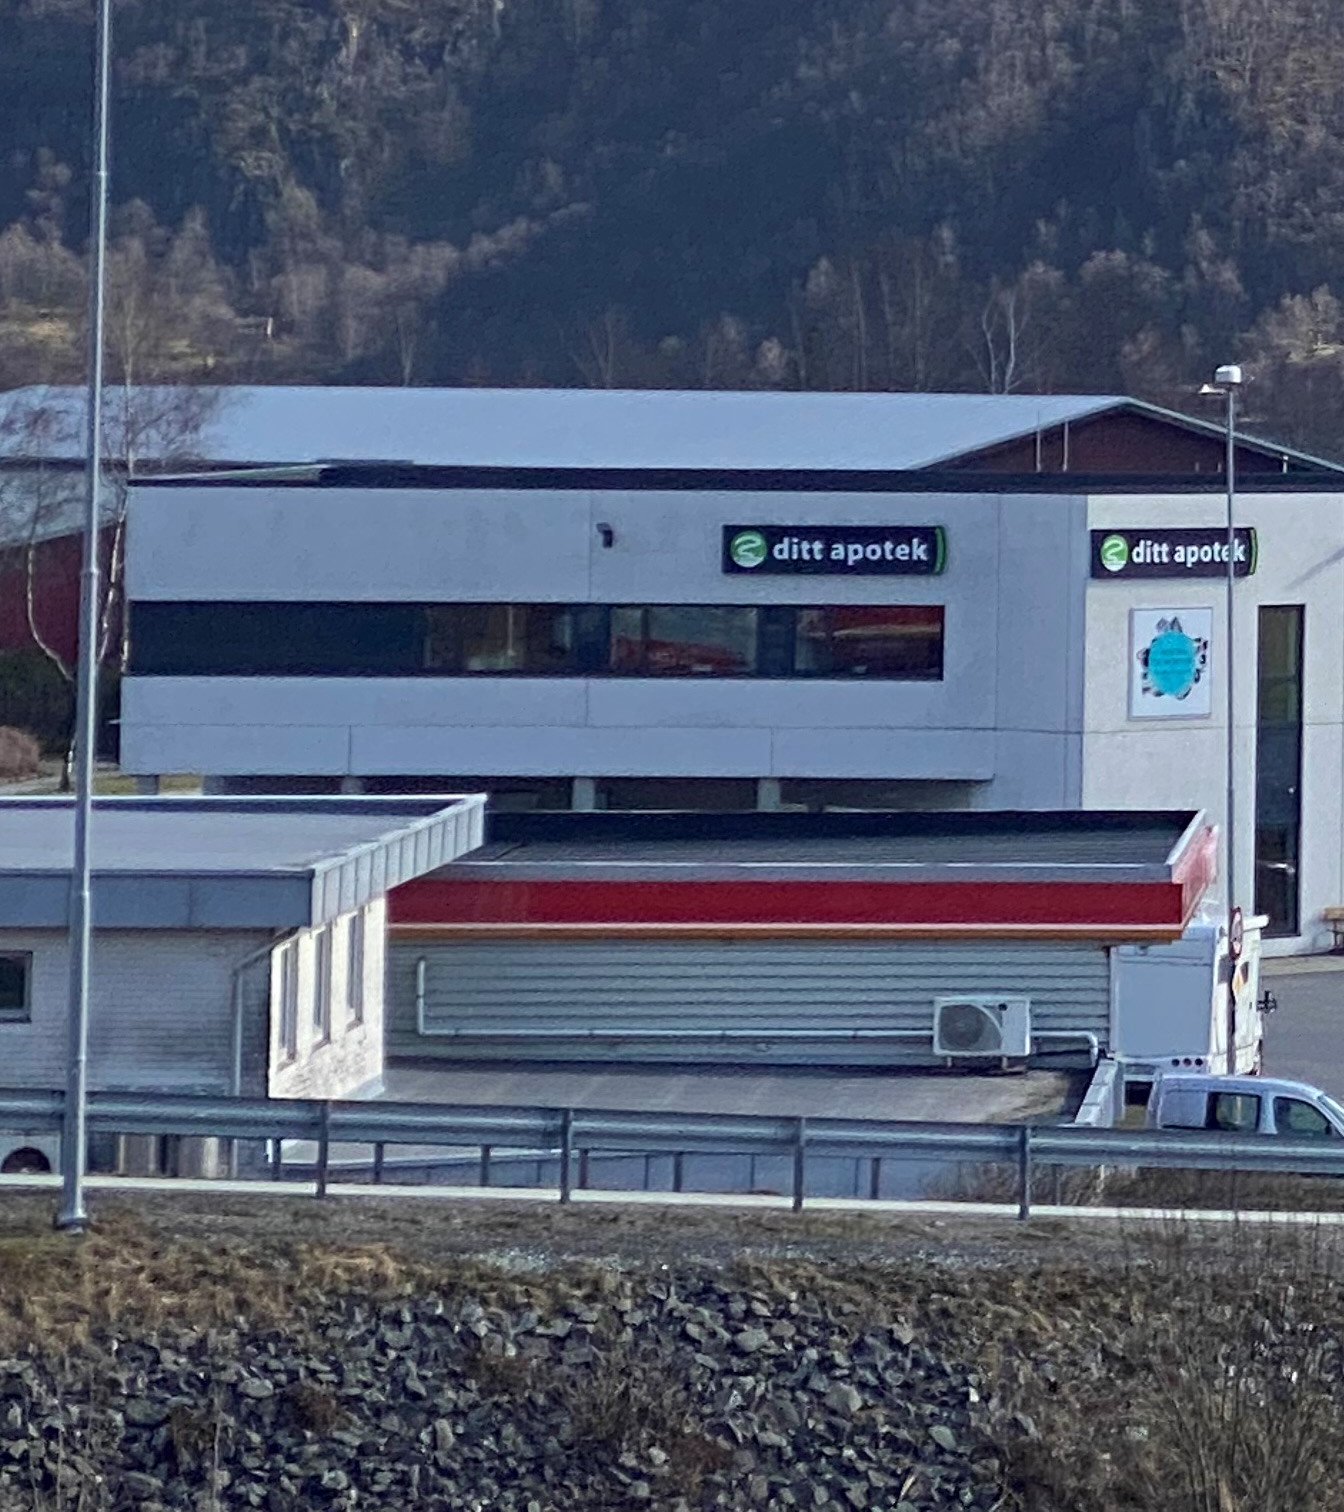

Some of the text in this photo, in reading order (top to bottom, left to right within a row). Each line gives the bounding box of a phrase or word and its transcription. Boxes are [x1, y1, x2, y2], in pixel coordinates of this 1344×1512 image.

[772, 536, 928, 566] ditt apotek
[1131, 536, 1246, 567] ditt apotek
